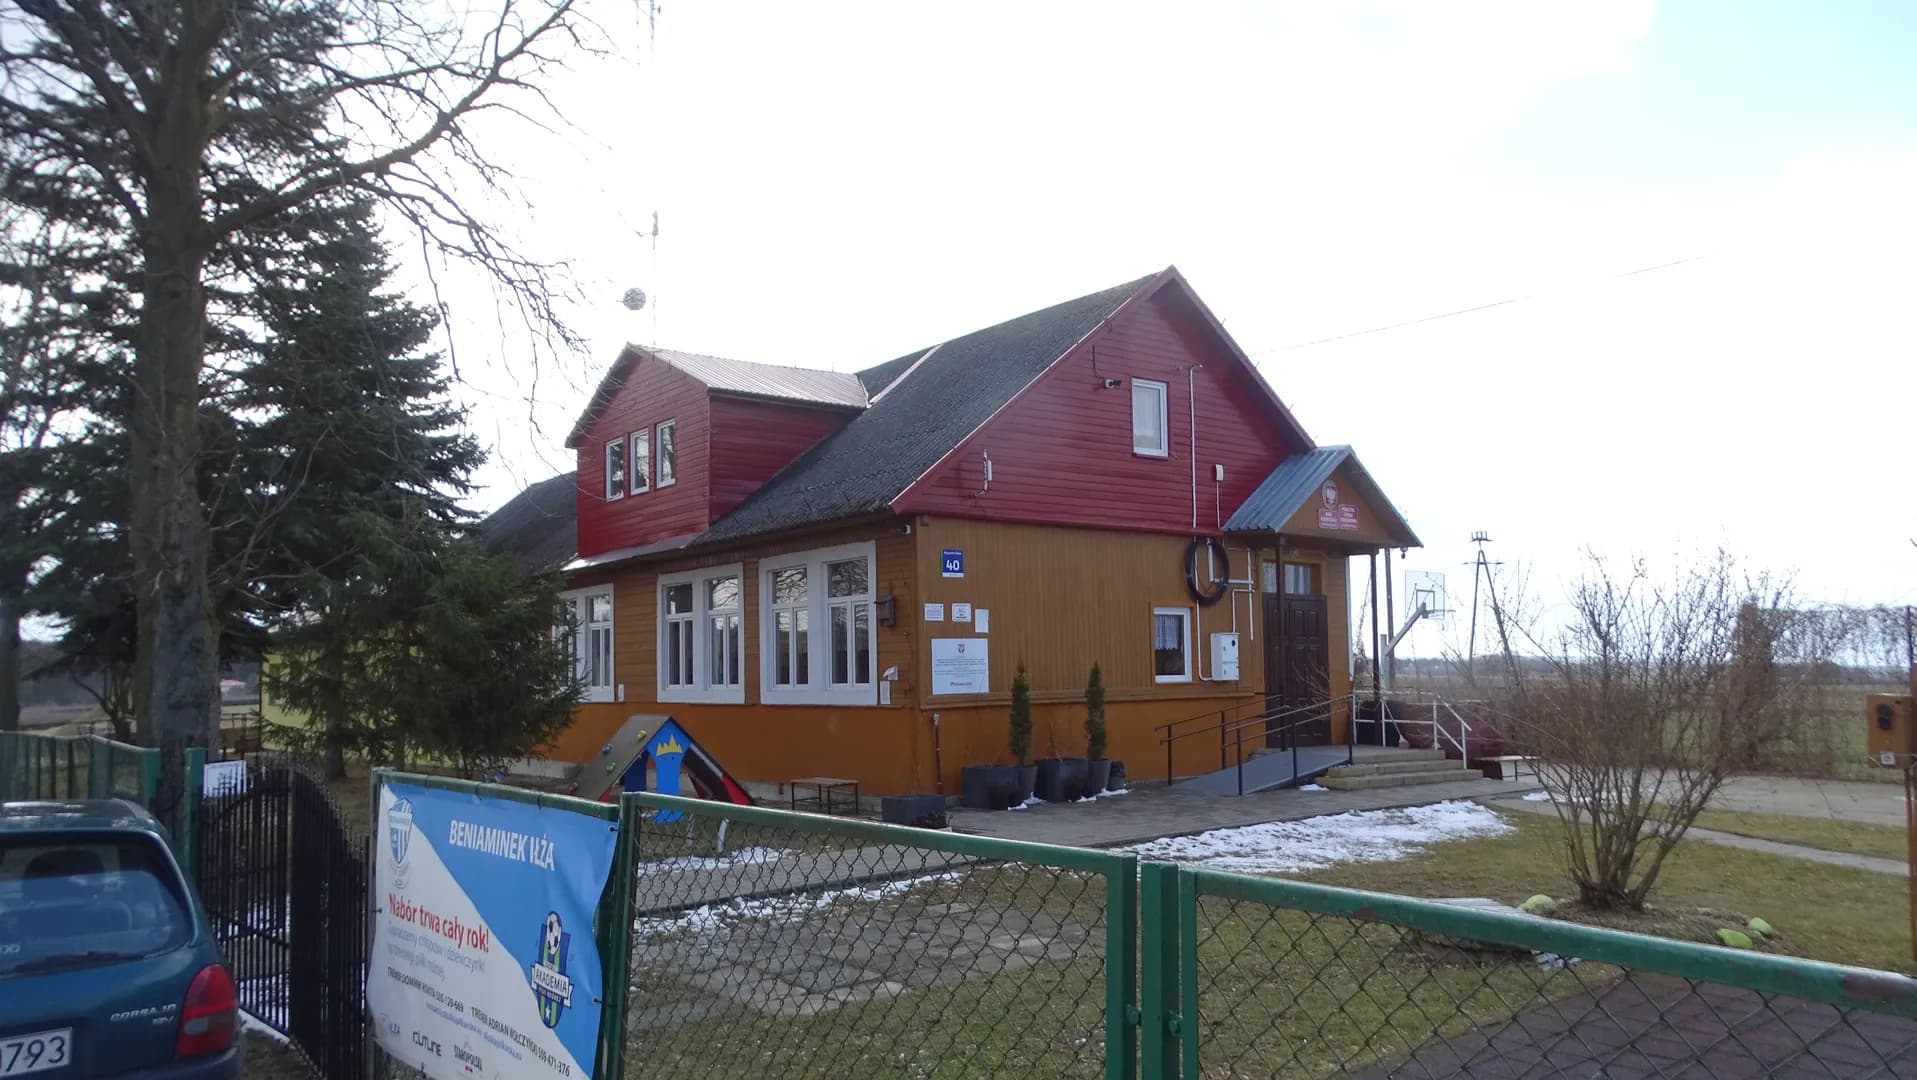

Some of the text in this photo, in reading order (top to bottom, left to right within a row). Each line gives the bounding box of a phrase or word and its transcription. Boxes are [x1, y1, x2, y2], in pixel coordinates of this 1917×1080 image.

[946, 559, 960, 571] 40
[449, 819, 528, 862] BENIAMINEK
[388, 892, 489, 953] Nabór trwa cały rok!
[535, 967, 568, 996] AKADEMIA
[0, 1035, 65, 1073] 793
